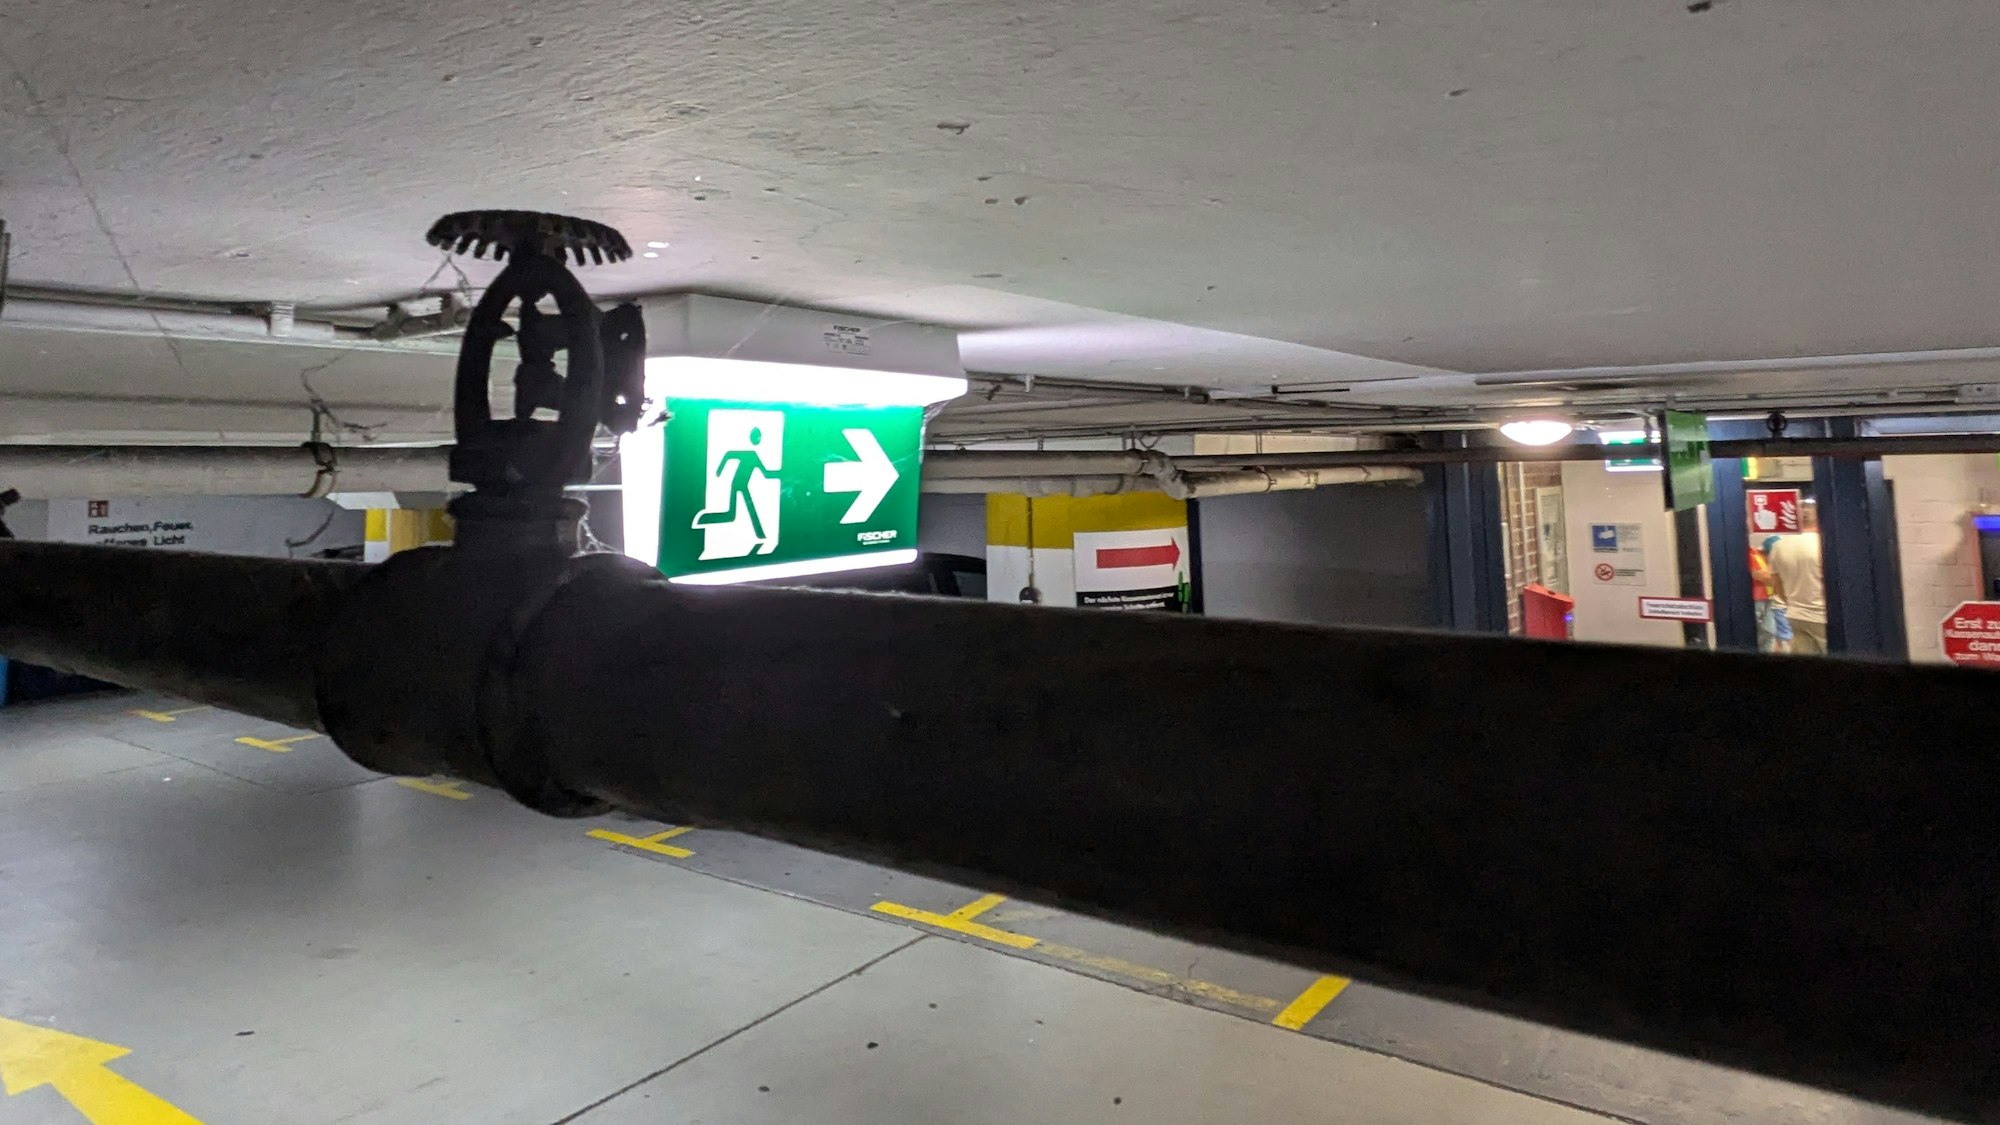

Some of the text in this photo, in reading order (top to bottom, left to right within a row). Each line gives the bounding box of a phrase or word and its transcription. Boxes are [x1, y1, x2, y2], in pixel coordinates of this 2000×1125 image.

[154, 534, 185, 546] Licht
[857, 530, 898, 541] FISCHER
[1954, 617, 1983, 629] Erst
